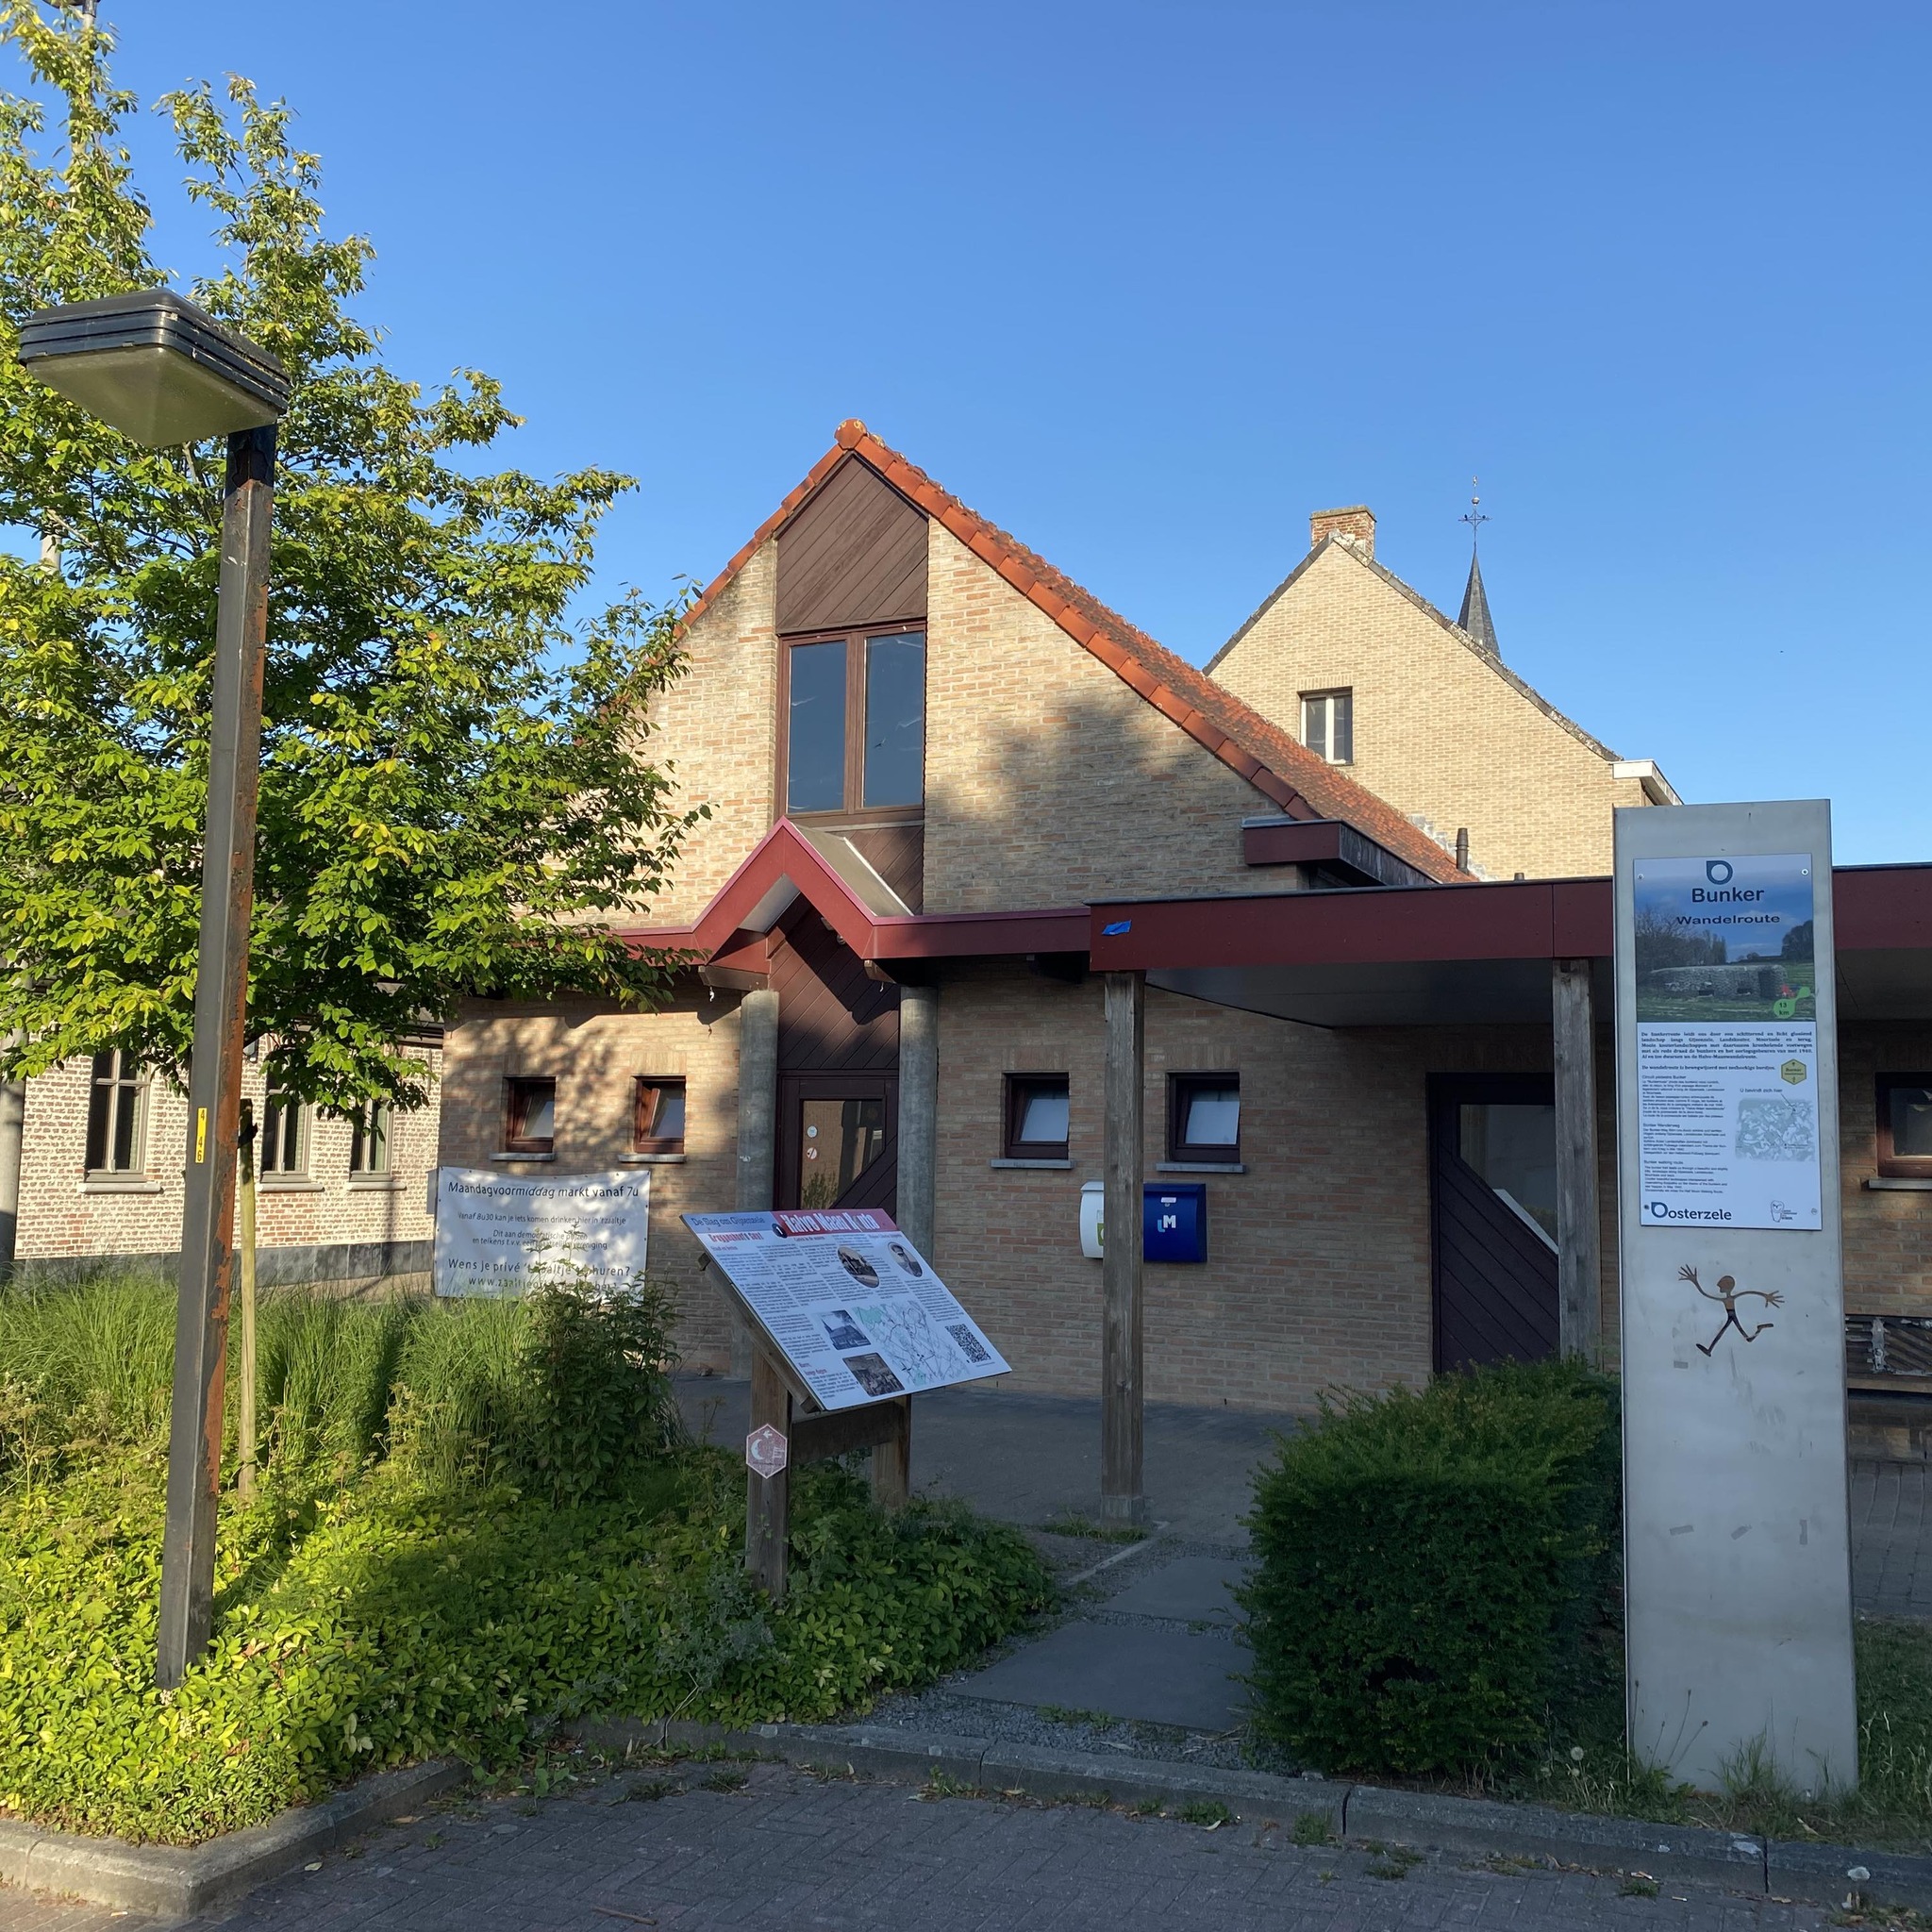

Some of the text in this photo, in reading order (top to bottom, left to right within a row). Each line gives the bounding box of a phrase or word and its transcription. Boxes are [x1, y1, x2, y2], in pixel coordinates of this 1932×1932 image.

[1691, 887, 1765, 904] Bunker
[1676, 914, 1781, 925] Wandelroute
[200, 1109, 206, 1121] 4
[448, 1182, 639, 1199] Maandagvoormiddag markt vanaf 7u
[458, 1211, 476, 1220] Vanaf
[495, 1213, 507, 1222] kan
[508, 1214, 514, 1224] je
[515, 1214, 525, 1223] iets
[526, 1215, 549, 1224] komen
[550, 1216, 577, 1224] drinken
[578, 1216, 591, 1224] hier
[591, 1216, 599, 1224] in
[691, 1218, 703, 1226] De
[703, 1217, 721, 1227] Slag
[780, 1213, 821, 1233] Halve
[813, 1212, 852, 1232] Maan
[492, 1229, 504, 1238] Dit
[480, 1237, 505, 1246] telkens
[448, 1258, 477, 1271] Wens
[480, 1260, 490, 1273] je
[493, 1261, 521, 1274] privé
[592, 1264, 630, 1276] huren?
